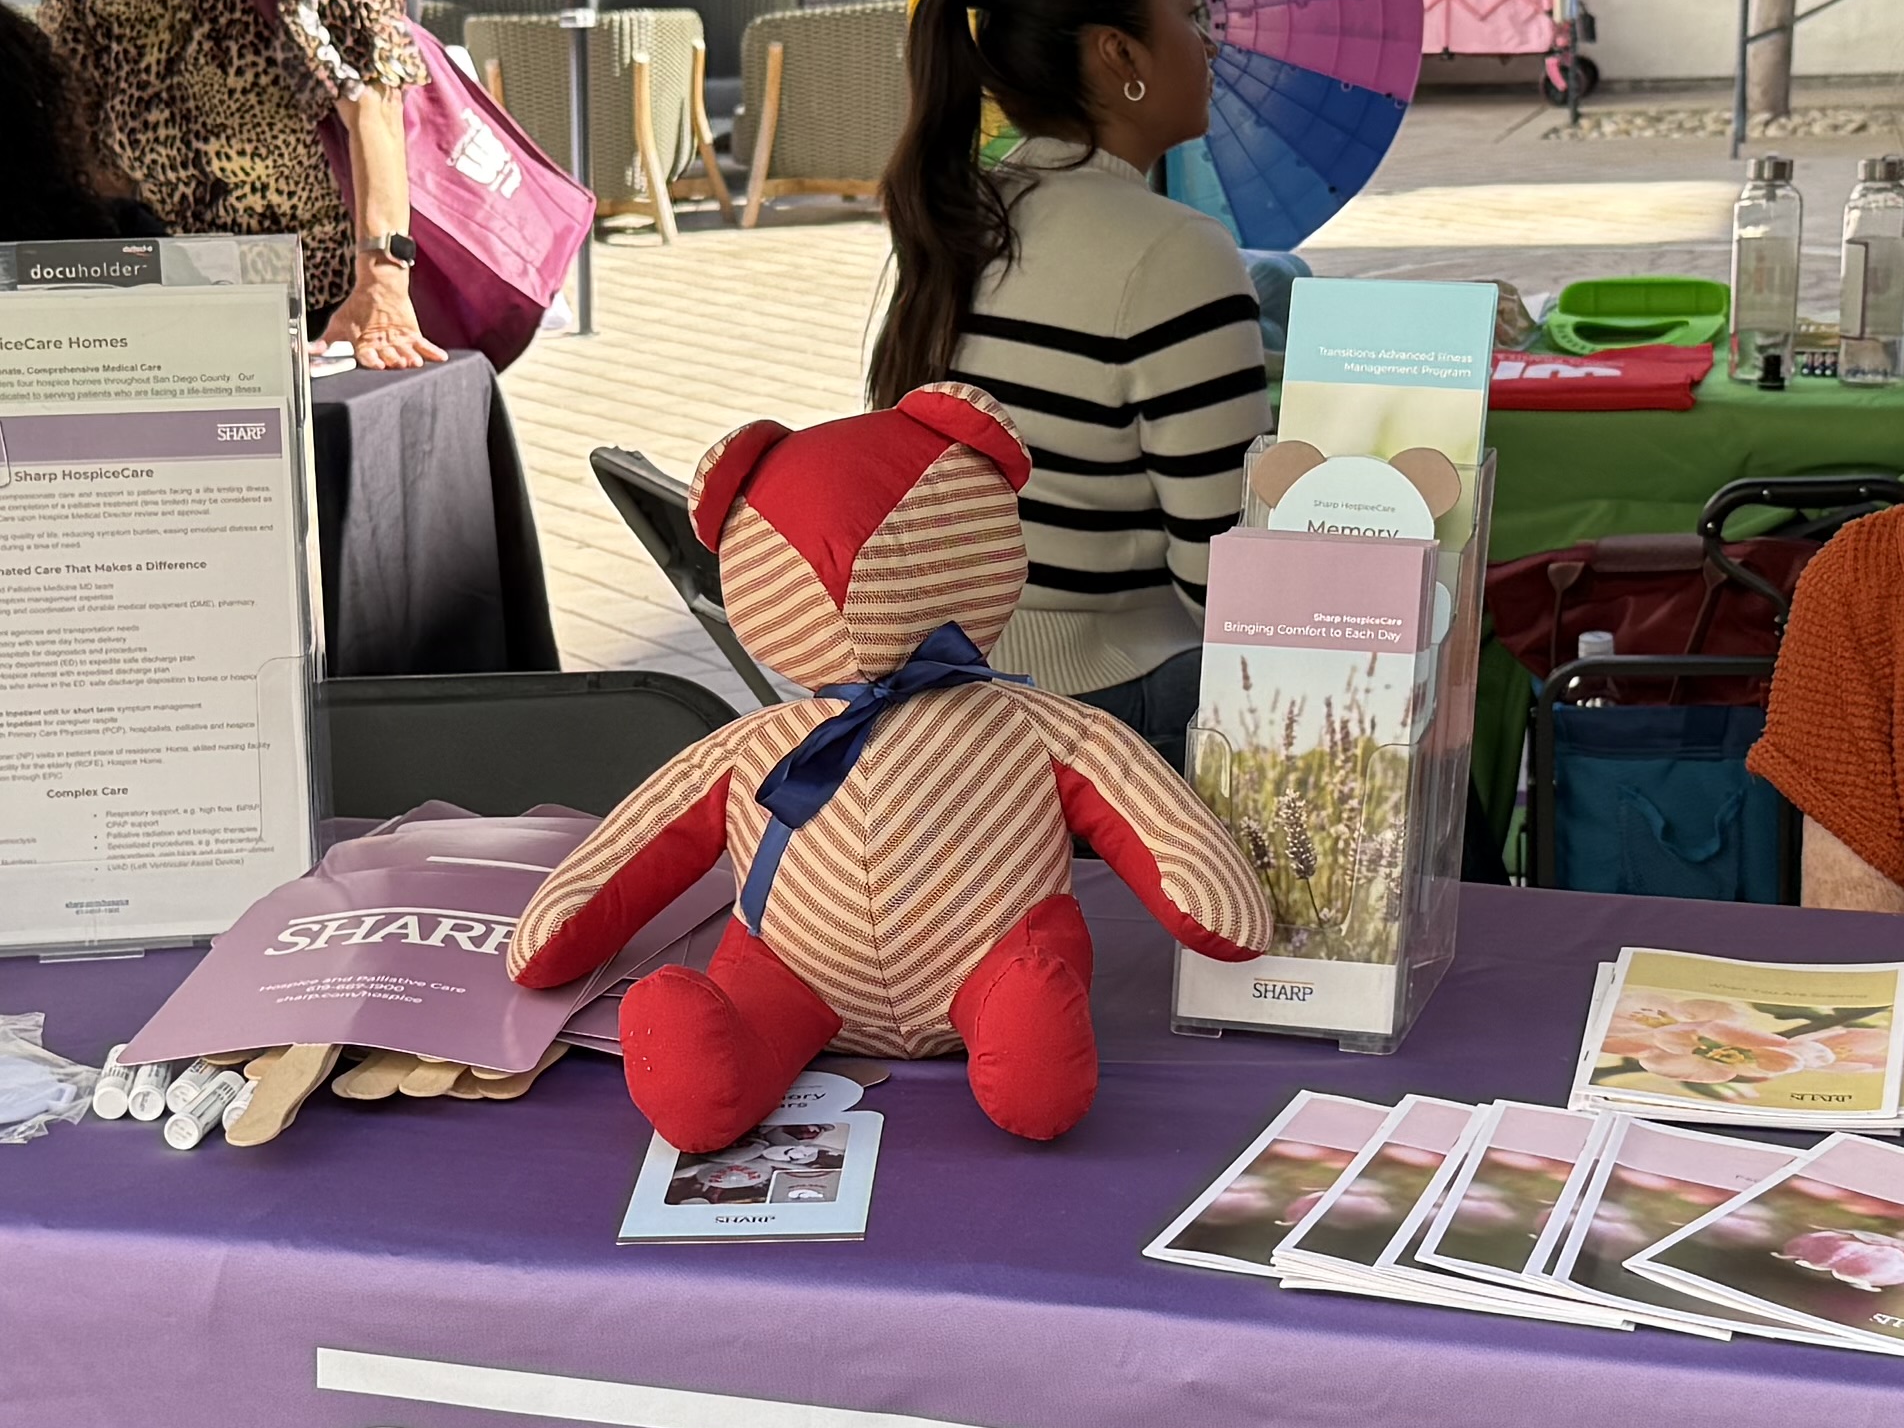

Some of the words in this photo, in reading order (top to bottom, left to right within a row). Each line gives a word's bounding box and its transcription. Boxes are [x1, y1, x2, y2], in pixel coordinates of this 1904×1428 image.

[67, 335, 128, 348] Homes
[1319, 346, 1376, 360] Transitions
[1378, 349, 1434, 362] Advanced
[1344, 362, 1418, 376] Management
[1422, 366, 1472, 379] Program
[217, 425, 266, 441] SHARP
[15, 468, 56, 483] Sharp
[60, 466, 154, 482] HospiceCare
[1314, 499, 1339, 510] Sharp
[34, 564, 61, 574] Care
[64, 563, 91, 573] That
[94, 562, 131, 572] Makes
[135, 563, 142, 571] a
[145, 559, 206, 570] Difference
[1313, 613, 1342, 624] Sharp
[1224, 621, 1274, 635] Bringing
[1277, 624, 1327, 637] Comfort
[1330, 627, 1343, 639] to
[1345, 628, 1375, 640] Each
[1378, 630, 1403, 644] Day
[47, 785, 98, 800] Complex
[101, 784, 128, 795] Care
[264, 911, 518, 956] SHARP
[259, 978, 320, 993] Hospice
[325, 975, 354, 985] and
[356, 975, 427, 989] Palliative
[431, 982, 467, 994] Care
[1251, 981, 1314, 1003] SHARP
